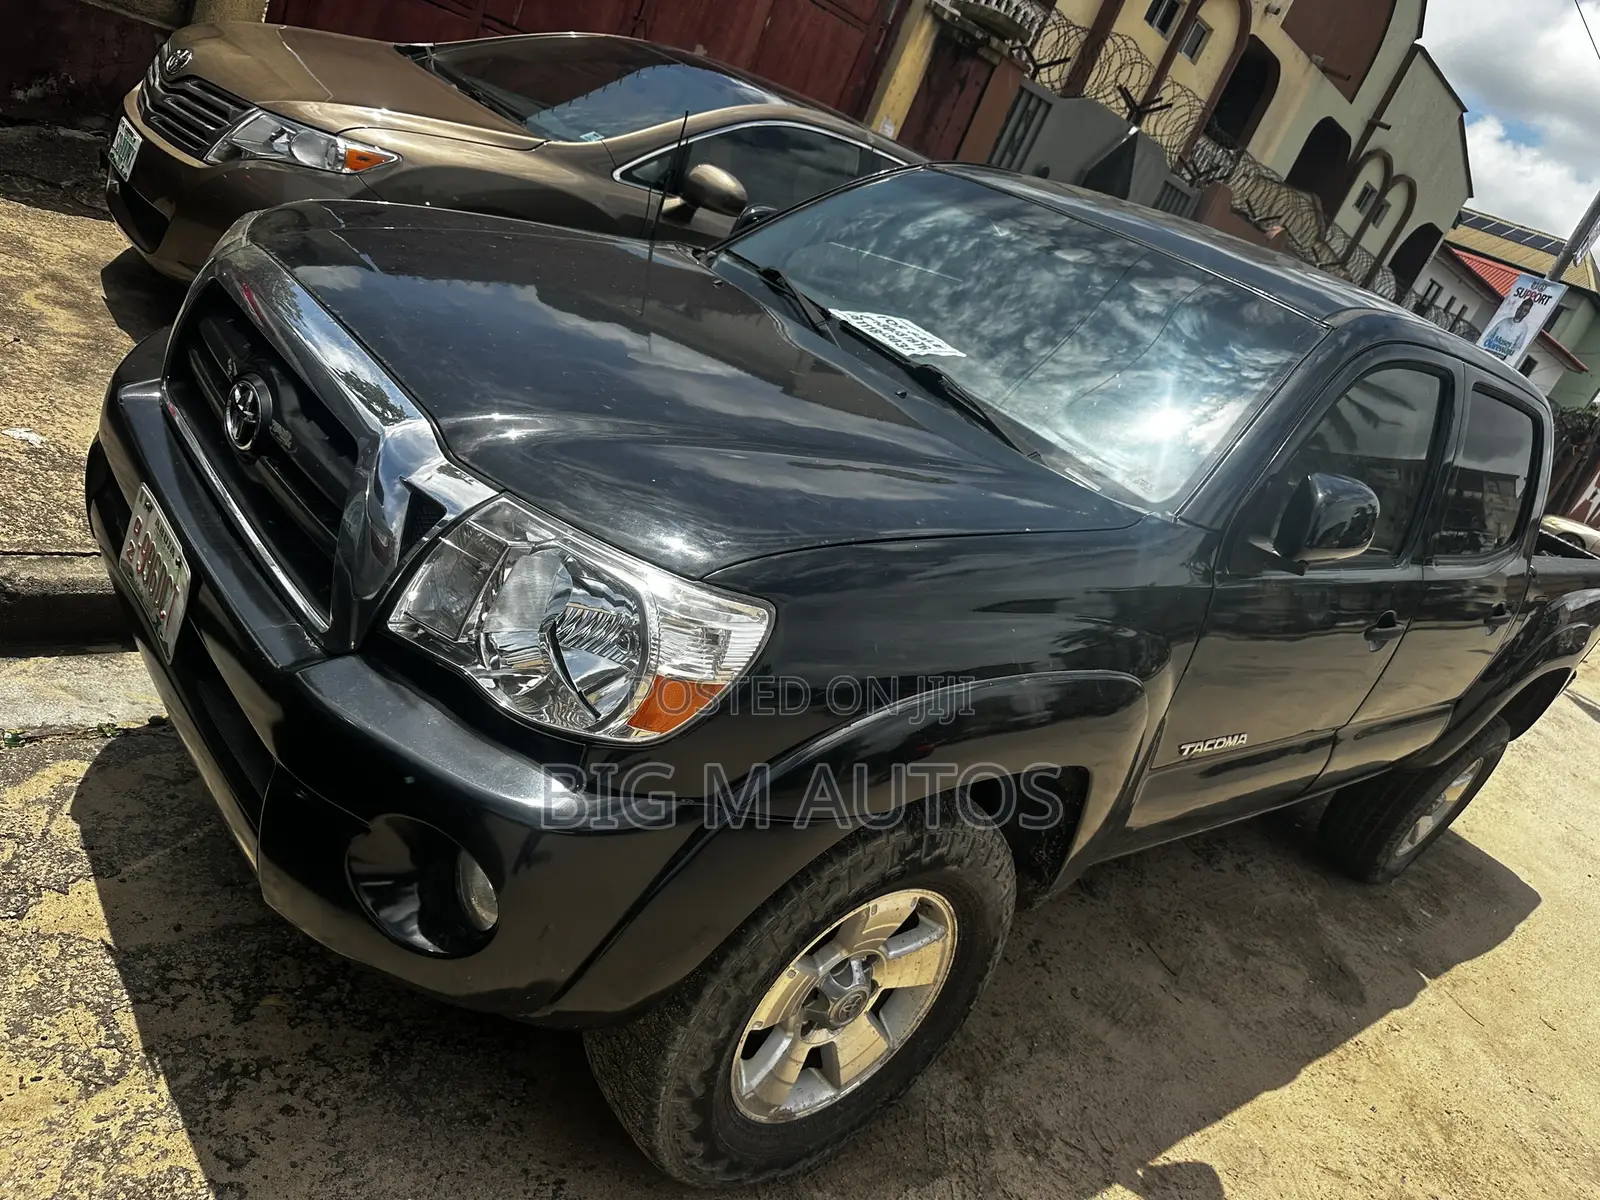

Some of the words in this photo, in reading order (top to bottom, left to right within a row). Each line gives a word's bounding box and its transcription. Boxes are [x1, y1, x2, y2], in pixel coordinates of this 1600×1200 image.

[1513, 287, 1552, 306] SUPPORT
[155, 518, 175, 559] ABUJA
[1178, 732, 1248, 756] TACOMA
